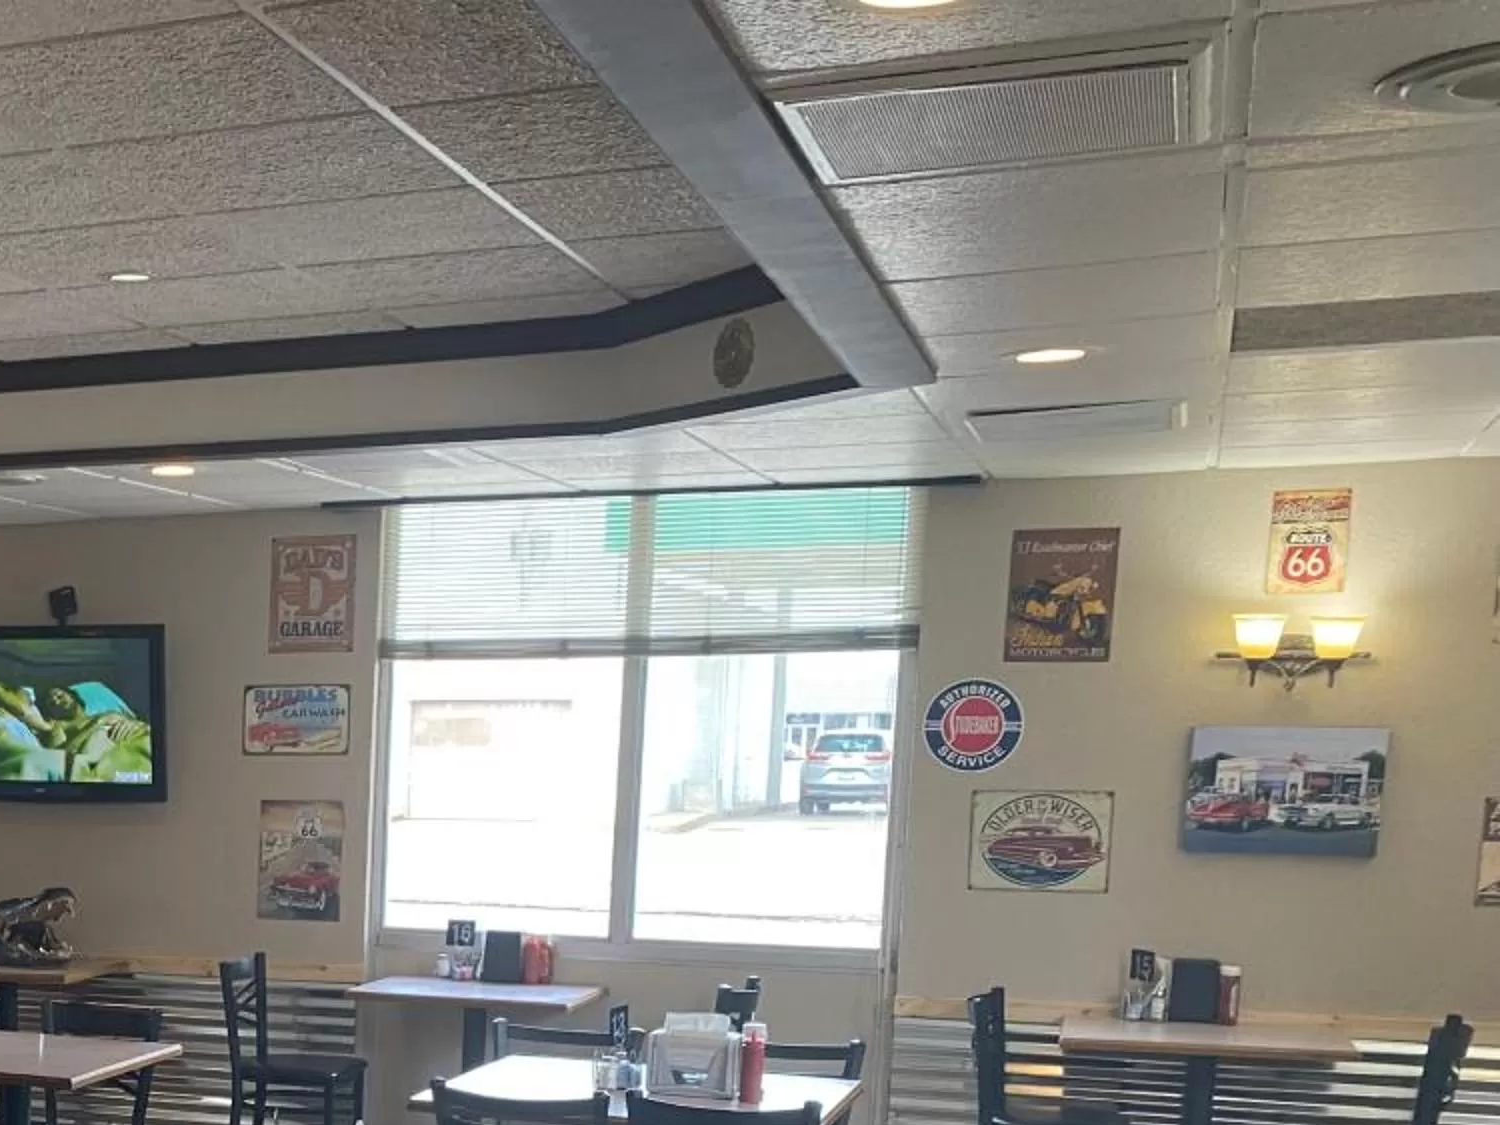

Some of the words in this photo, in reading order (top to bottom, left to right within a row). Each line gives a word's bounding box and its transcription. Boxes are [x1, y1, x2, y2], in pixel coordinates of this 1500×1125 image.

[1287, 547, 1326, 577] 66
[279, 620, 345, 637] GARAGE
[254, 688, 339, 703] BUBBLES
[940, 685, 1011, 709] AUTHORIZED
[938, 745, 1007, 767] SERVICE
[987, 799, 1034, 831] OLDER
[1050, 799, 1094, 832] WISER
[301, 822, 318, 837] 66
